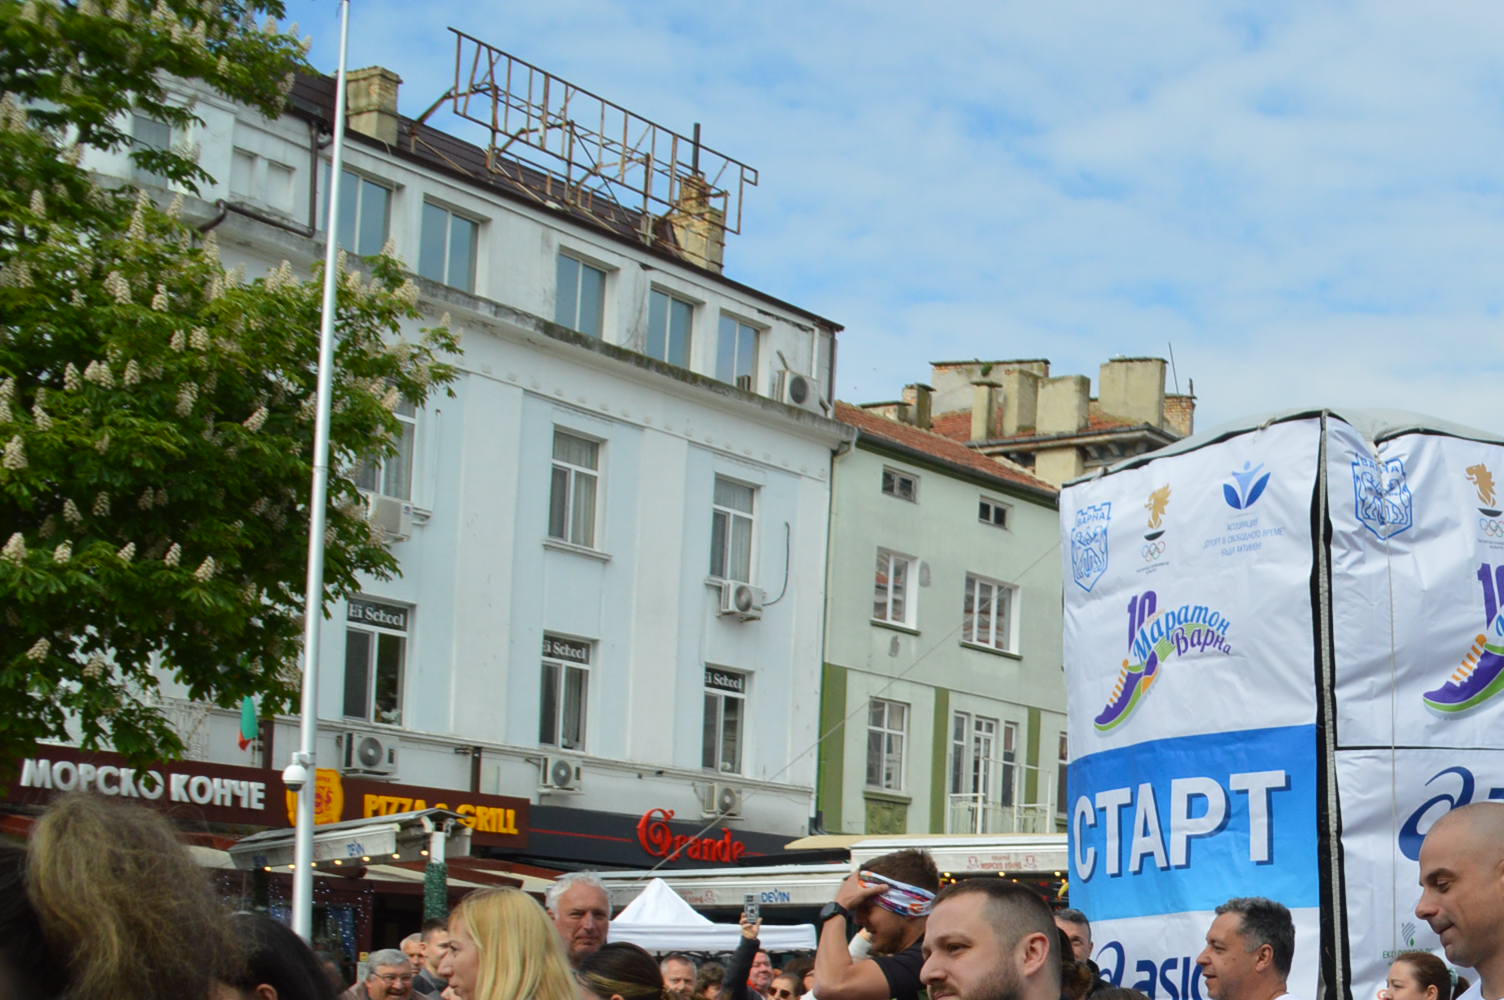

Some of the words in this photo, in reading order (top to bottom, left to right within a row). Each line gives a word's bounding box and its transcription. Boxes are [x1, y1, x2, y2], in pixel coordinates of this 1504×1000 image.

[1133, 605, 1231, 664] Маратон
[1171, 627, 1232, 656] Варна
[20, 758, 164, 800] МОРСКО
[170, 773, 266, 811] КОНЧЕ
[456, 804, 519, 835] GRILL
[636, 807, 747, 863] Grande
[1073, 769, 1291, 882] СТАРТ
